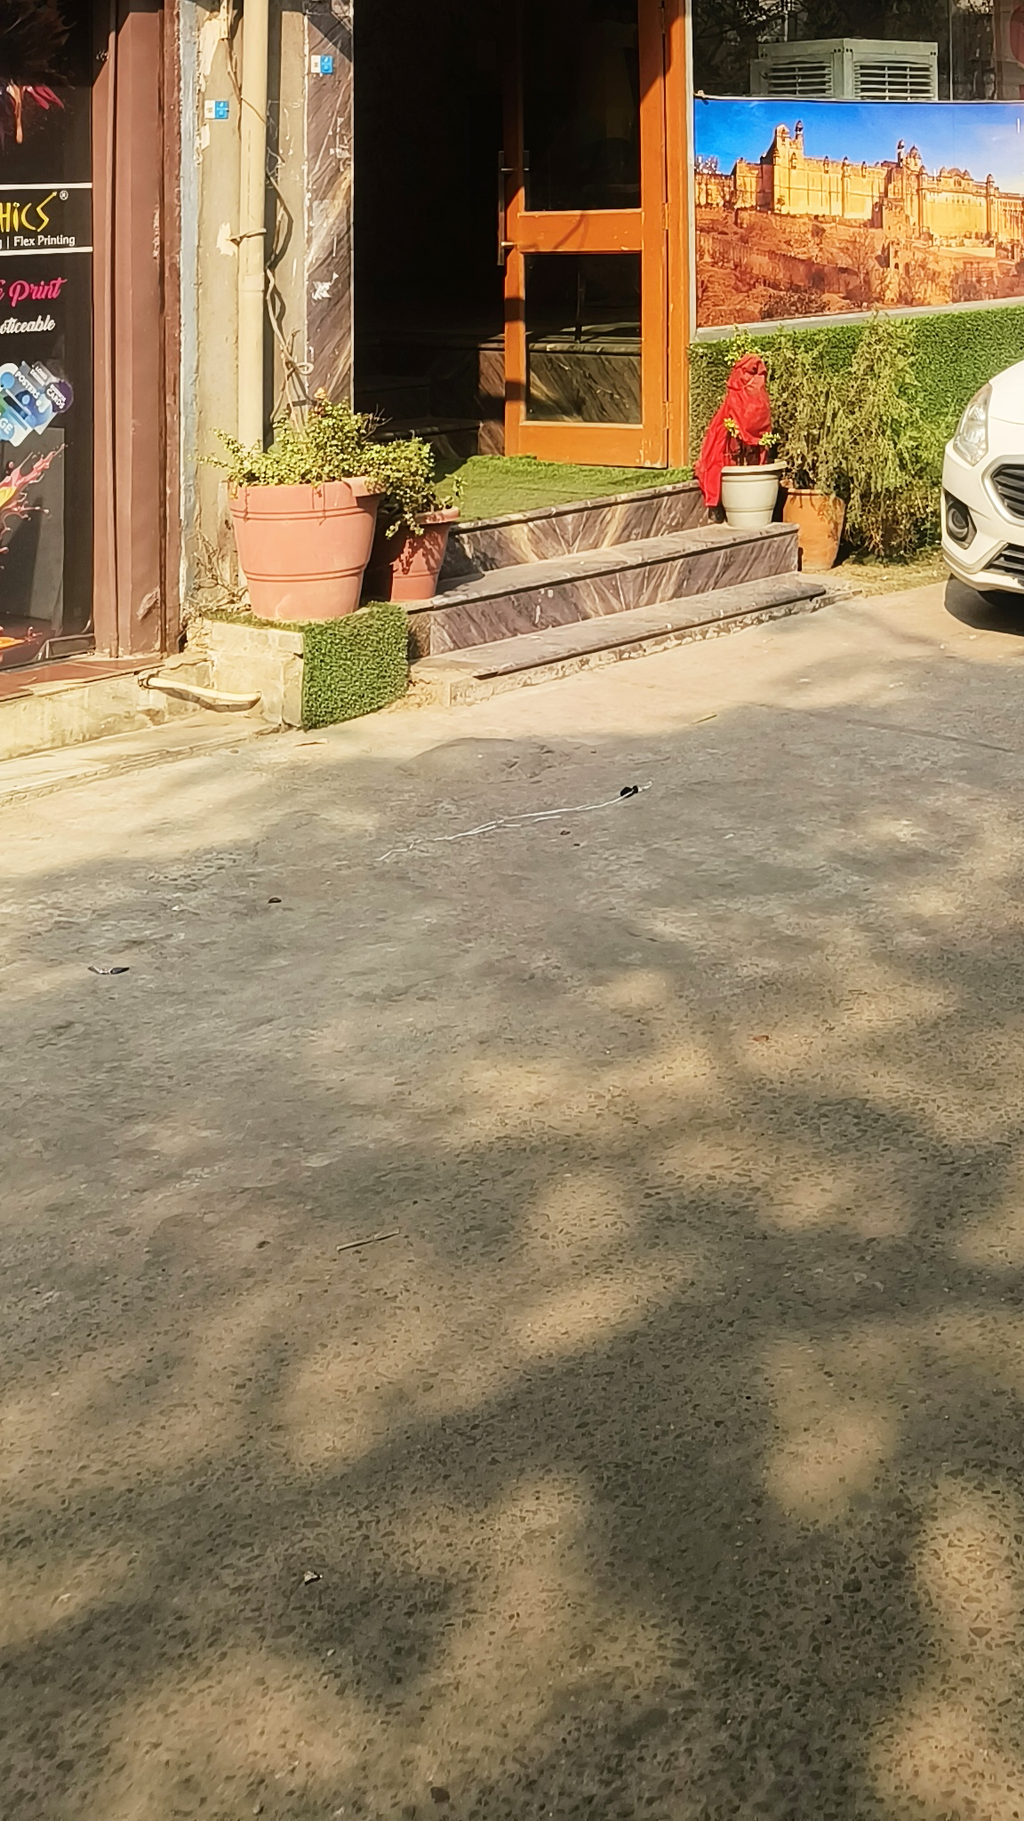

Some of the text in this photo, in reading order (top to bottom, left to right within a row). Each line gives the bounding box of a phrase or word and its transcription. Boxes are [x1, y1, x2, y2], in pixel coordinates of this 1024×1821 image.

[13, 235, 36, 247] Flex
[37, 234, 76, 247] Printing
[9, 277, 68, 308] Print
